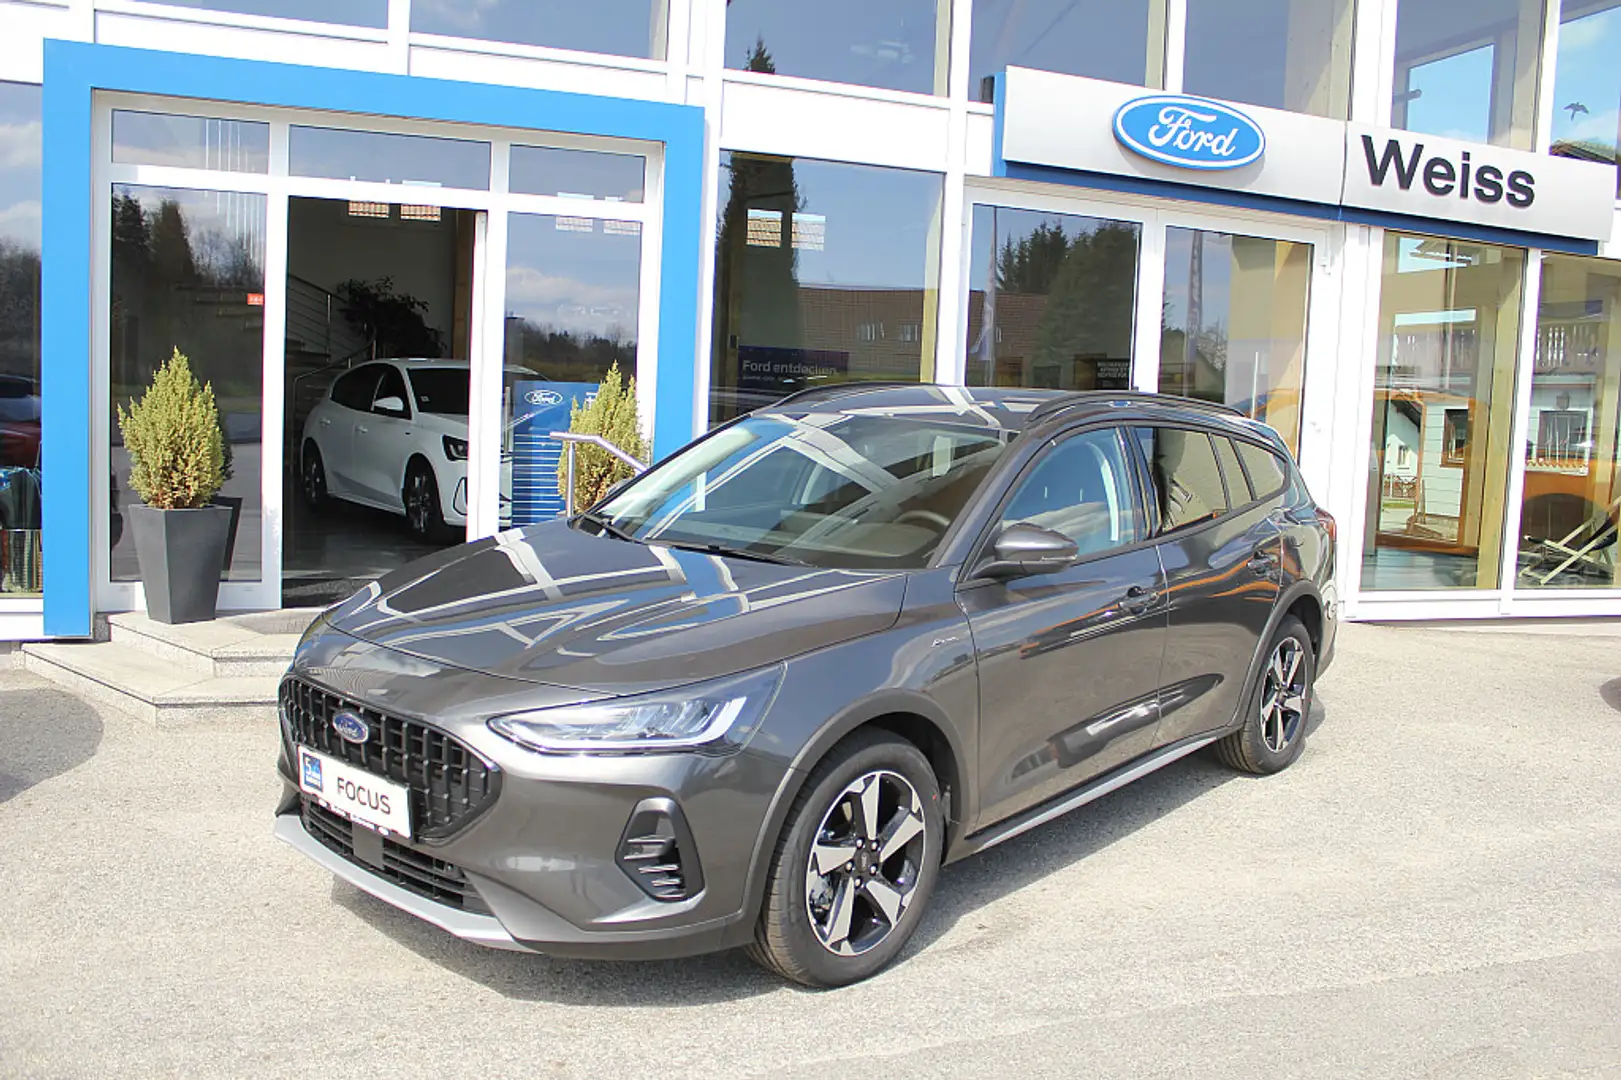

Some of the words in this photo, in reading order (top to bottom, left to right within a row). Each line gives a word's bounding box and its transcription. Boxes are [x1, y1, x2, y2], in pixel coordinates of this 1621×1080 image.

[1148, 106, 1239, 156] Ford
[1361, 134, 1535, 208] Weiss
[743, 360, 771, 372] Ford
[337, 776, 391, 815] FOCUS
